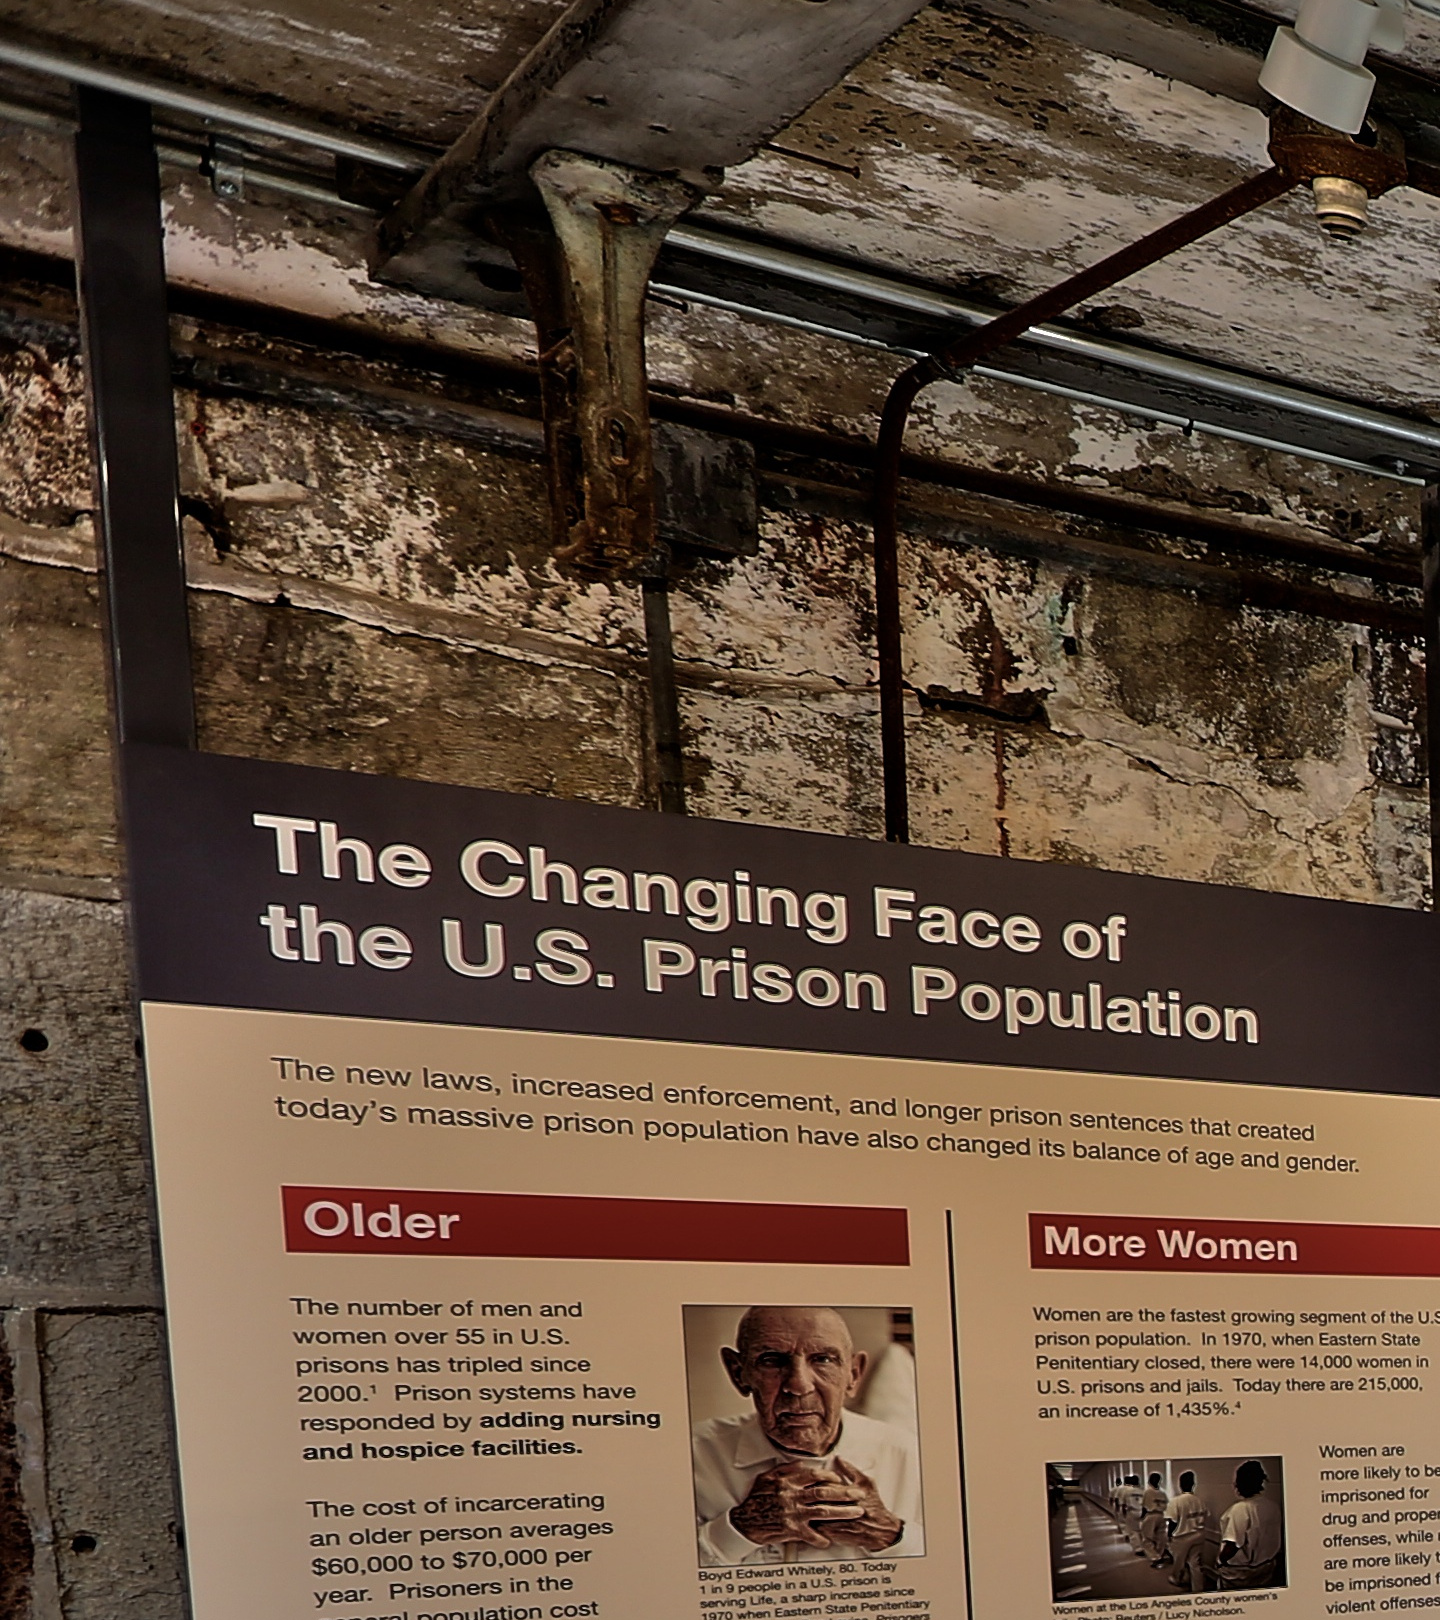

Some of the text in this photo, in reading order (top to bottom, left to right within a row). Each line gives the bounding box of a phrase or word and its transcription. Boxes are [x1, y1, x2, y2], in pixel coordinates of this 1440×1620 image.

[252, 814, 1126, 962] The Changing Face of
[260, 904, 1258, 1044] the U.S. Prison Population
[270, 1057, 1314, 1143] The new laws, increased enforcement, and longer prison sentences that created
[274, 1096, 1359, 1174] today's massive prison population have also changed its balance of age and gender.
[304, 1200, 460, 1239] Older
[1044, 1226, 1298, 1261] More Women
[289, 1298, 582, 1318] The number of men and
[292, 1328, 570, 1345] women over 55 in U.S.
